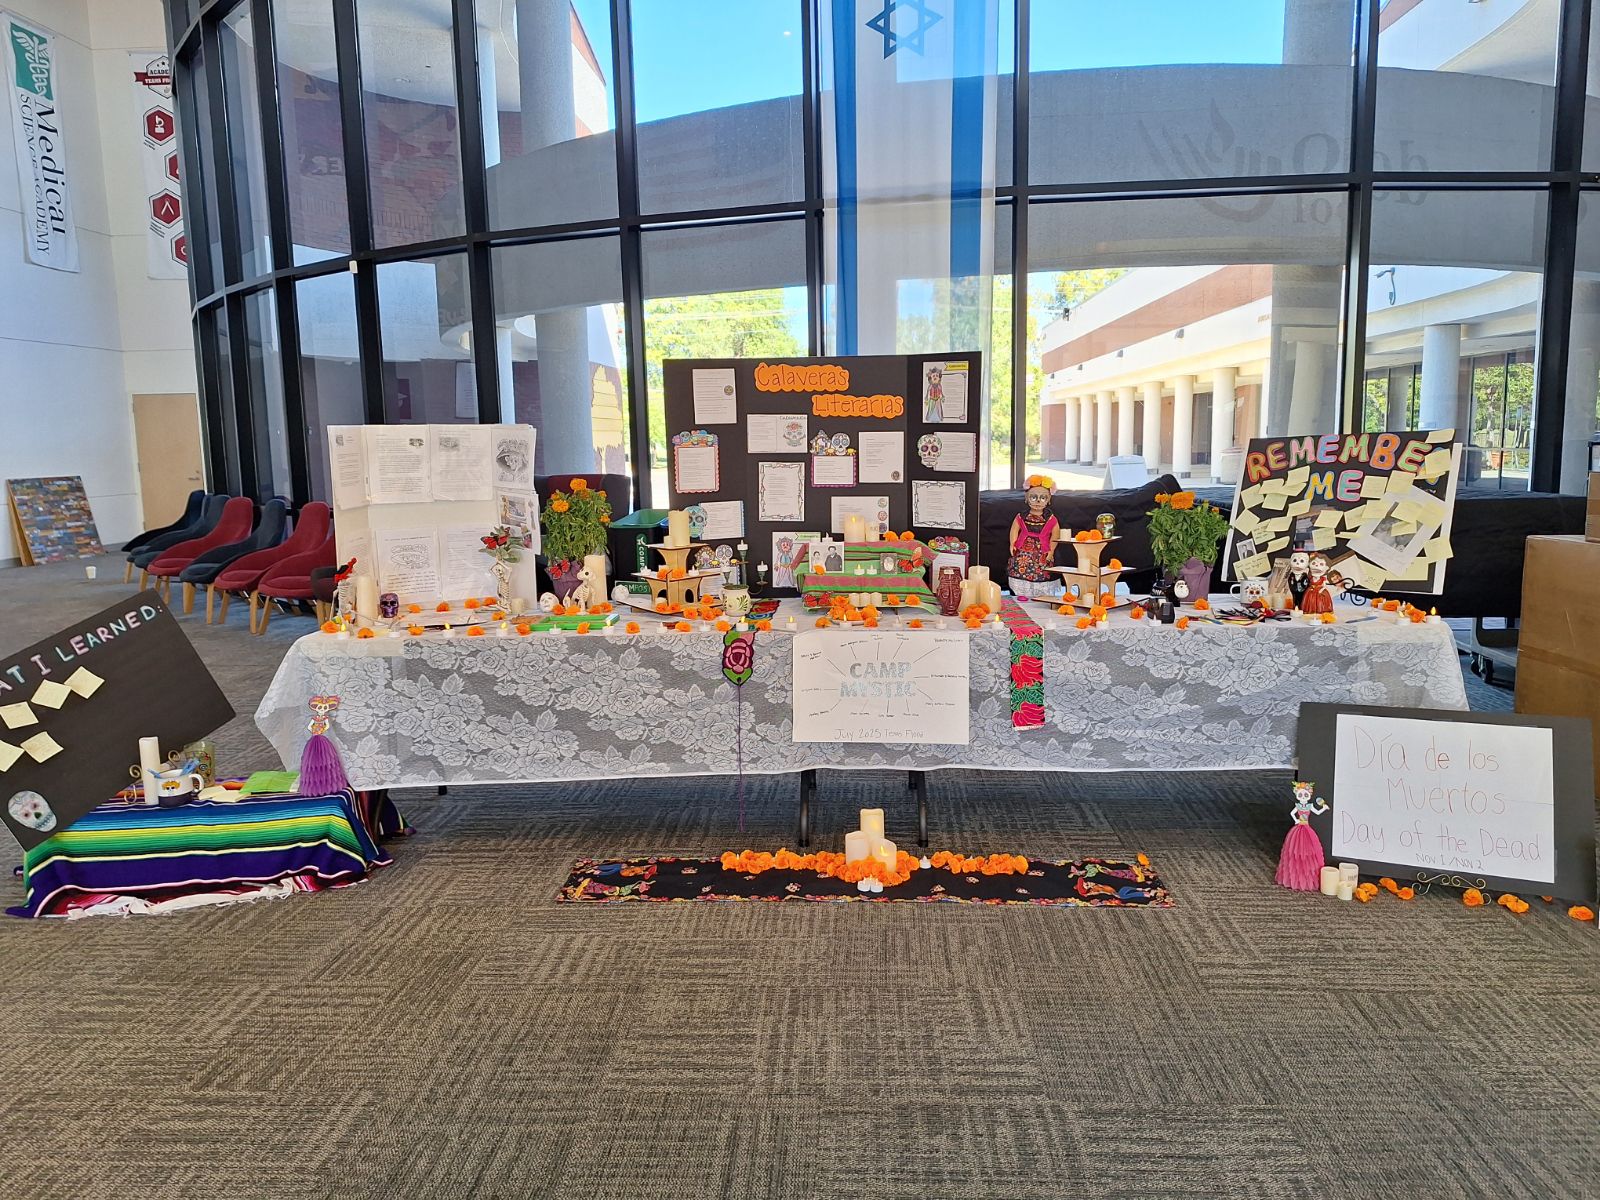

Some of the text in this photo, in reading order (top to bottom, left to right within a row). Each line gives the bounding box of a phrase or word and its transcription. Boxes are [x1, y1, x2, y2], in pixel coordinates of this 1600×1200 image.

[34, 99, 67, 236] Medical
[757, 364, 848, 387] Calaveras
[814, 395, 903, 415] Literarias
[1247, 433, 1450, 485] REMEMBE
[1304, 470, 1364, 502] ME
[30, 653, 52, 677] I
[54, 604, 164, 662] LEARNED:
[840, 680, 917, 698] MYSTIC
[849, 662, 912, 679] CAMP
[1353, 725, 1500, 772] Día de los
[1386, 777, 1506, 816] Muertos
[1341, 810, 1542, 861] Day of the Dead
